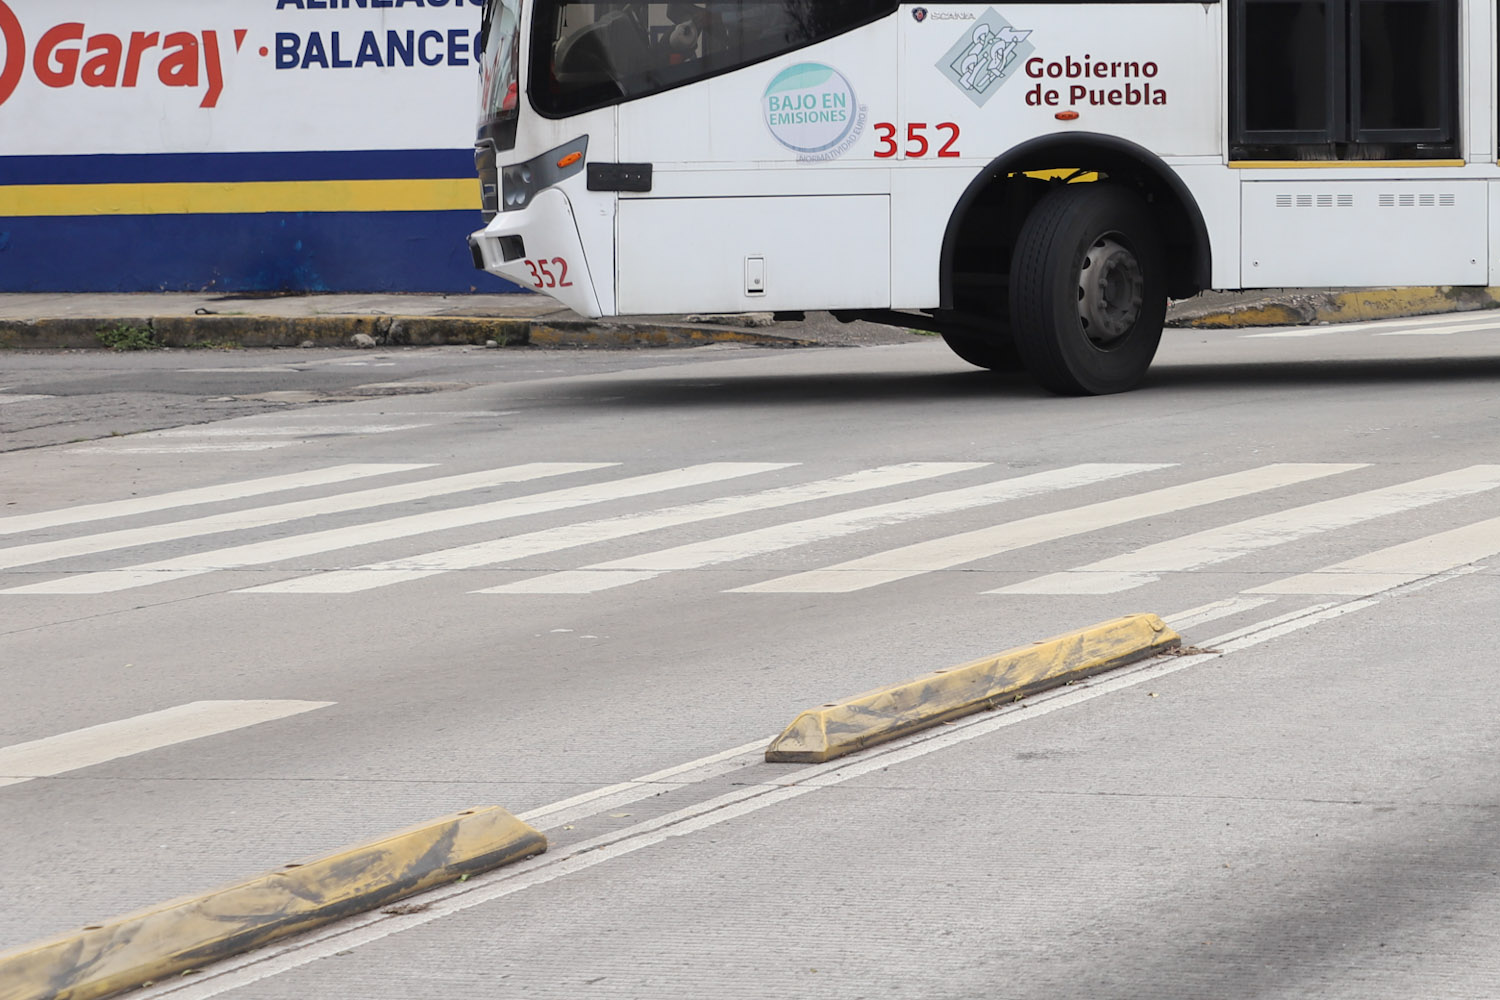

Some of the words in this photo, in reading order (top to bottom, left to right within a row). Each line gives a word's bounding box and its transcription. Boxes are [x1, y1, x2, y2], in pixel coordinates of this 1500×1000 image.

[931, 11, 976, 20] SCANIA
[33, 22, 248, 109] Garay
[1025, 54, 1158, 79] Gobierno
[769, 94, 817, 112] BAJO
[822, 92, 846, 108] EN
[1025, 84, 1059, 106] de
[1070, 83, 1167, 106] Puebla
[770, 110, 847, 125] EMISIONES
[798, 134, 858, 163] NORMATIVIDAD
[853, 113, 867, 136] EURO
[873, 122, 961, 158] 352
[524, 257, 573, 288] 352
